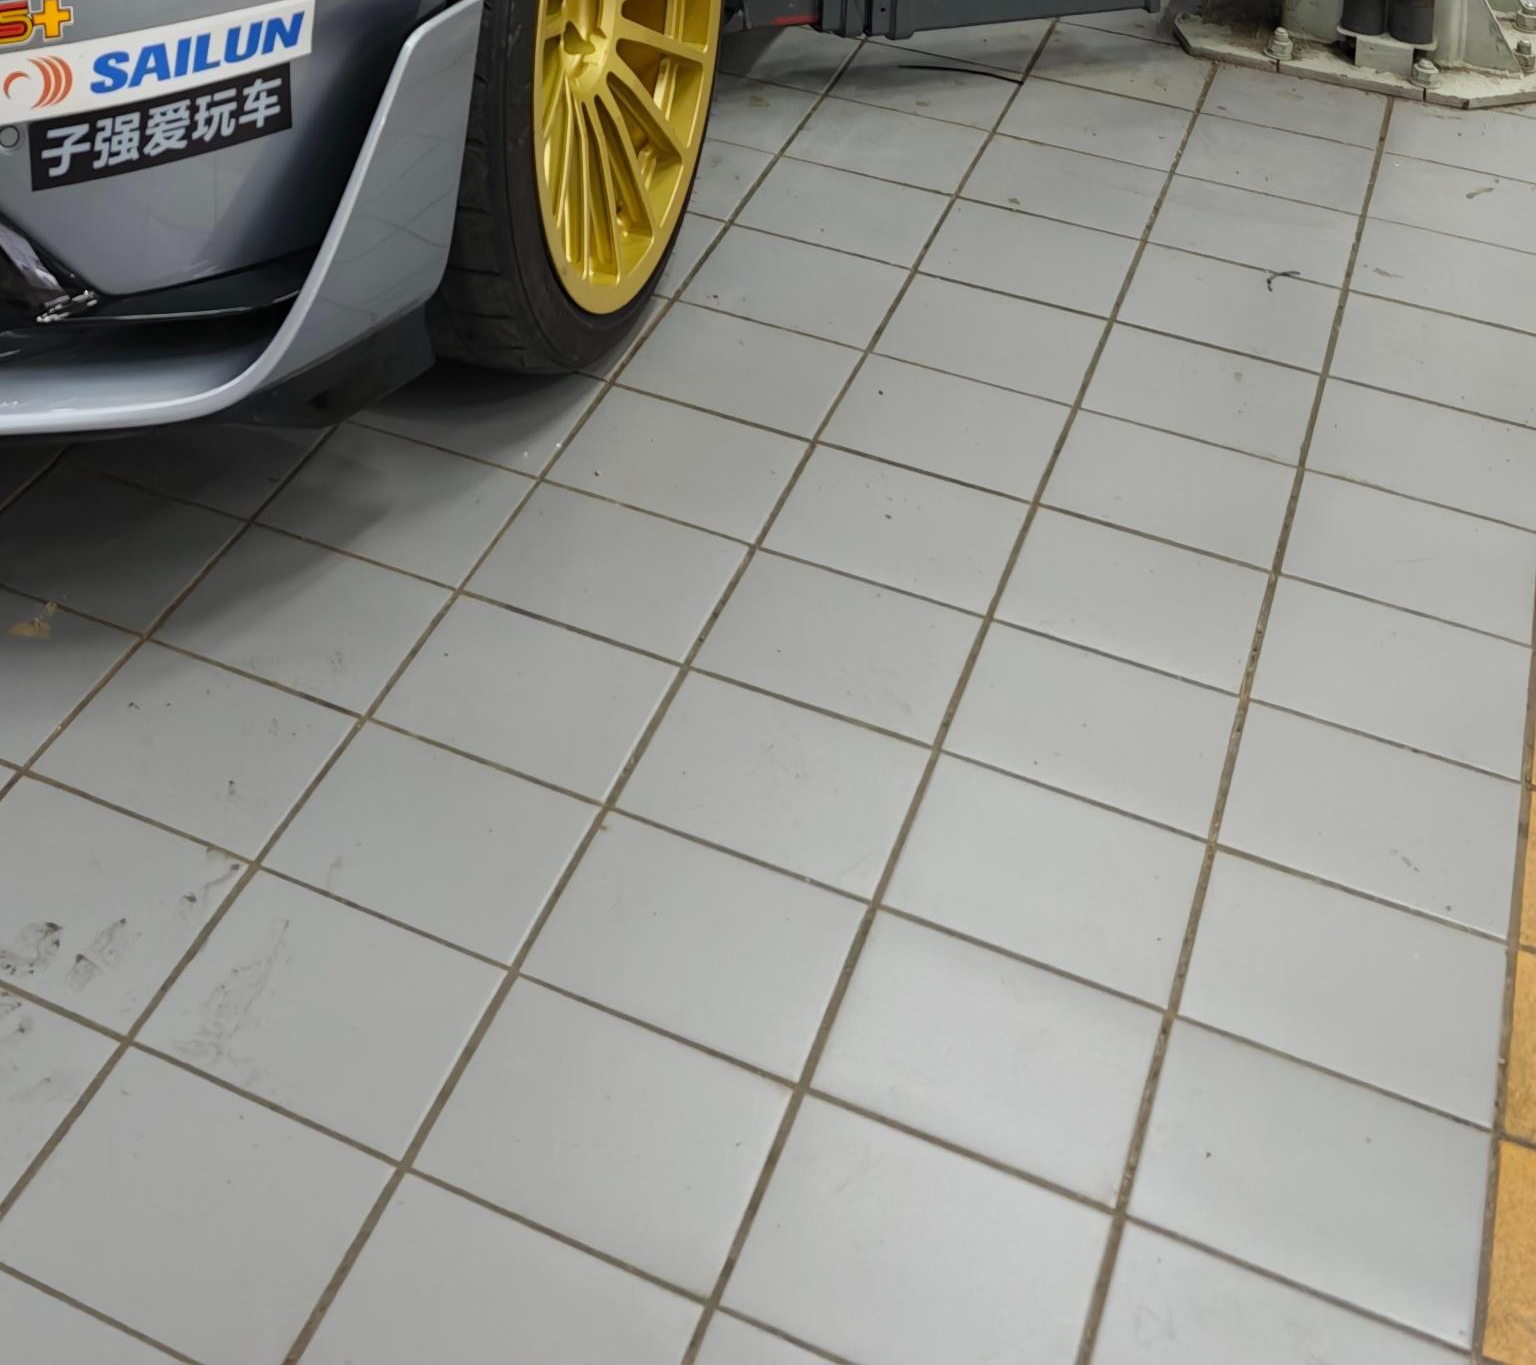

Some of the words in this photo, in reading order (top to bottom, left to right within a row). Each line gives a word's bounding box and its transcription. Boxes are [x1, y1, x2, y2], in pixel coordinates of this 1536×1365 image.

[90, 11, 305, 95] SAILUN
[40, 77, 282, 178] 子强爱玩车
